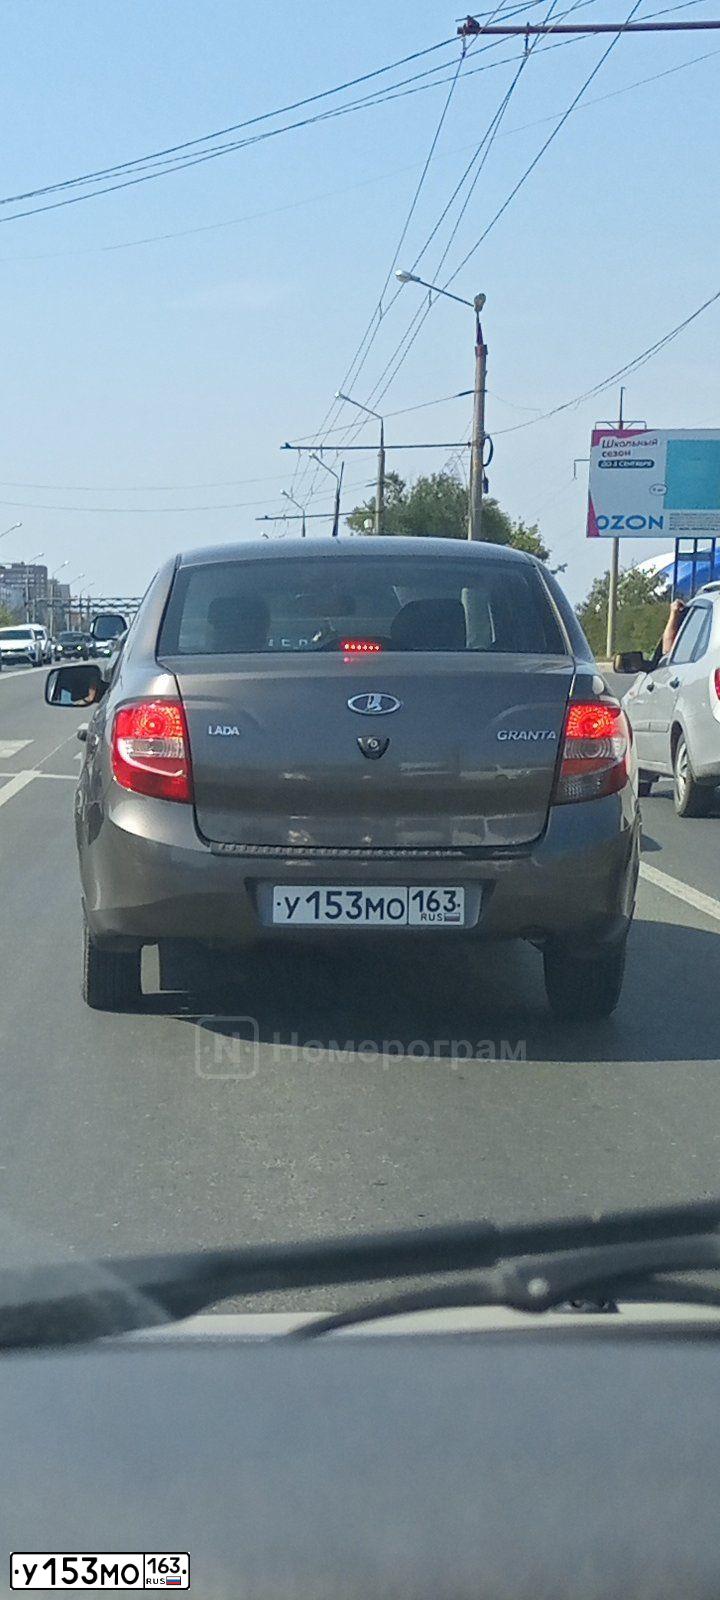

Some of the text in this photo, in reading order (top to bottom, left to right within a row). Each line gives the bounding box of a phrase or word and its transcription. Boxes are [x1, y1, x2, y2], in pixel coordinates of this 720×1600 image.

[602, 438, 658, 449] Школьный
[602, 450, 631, 458] сезон
[595, 515, 664, 530] OZON
[208, 725, 240, 736] LADA
[497, 730, 557, 740] GRANTA
[412, 889, 457, 913] 163
[420, 912, 443, 922] RUS
